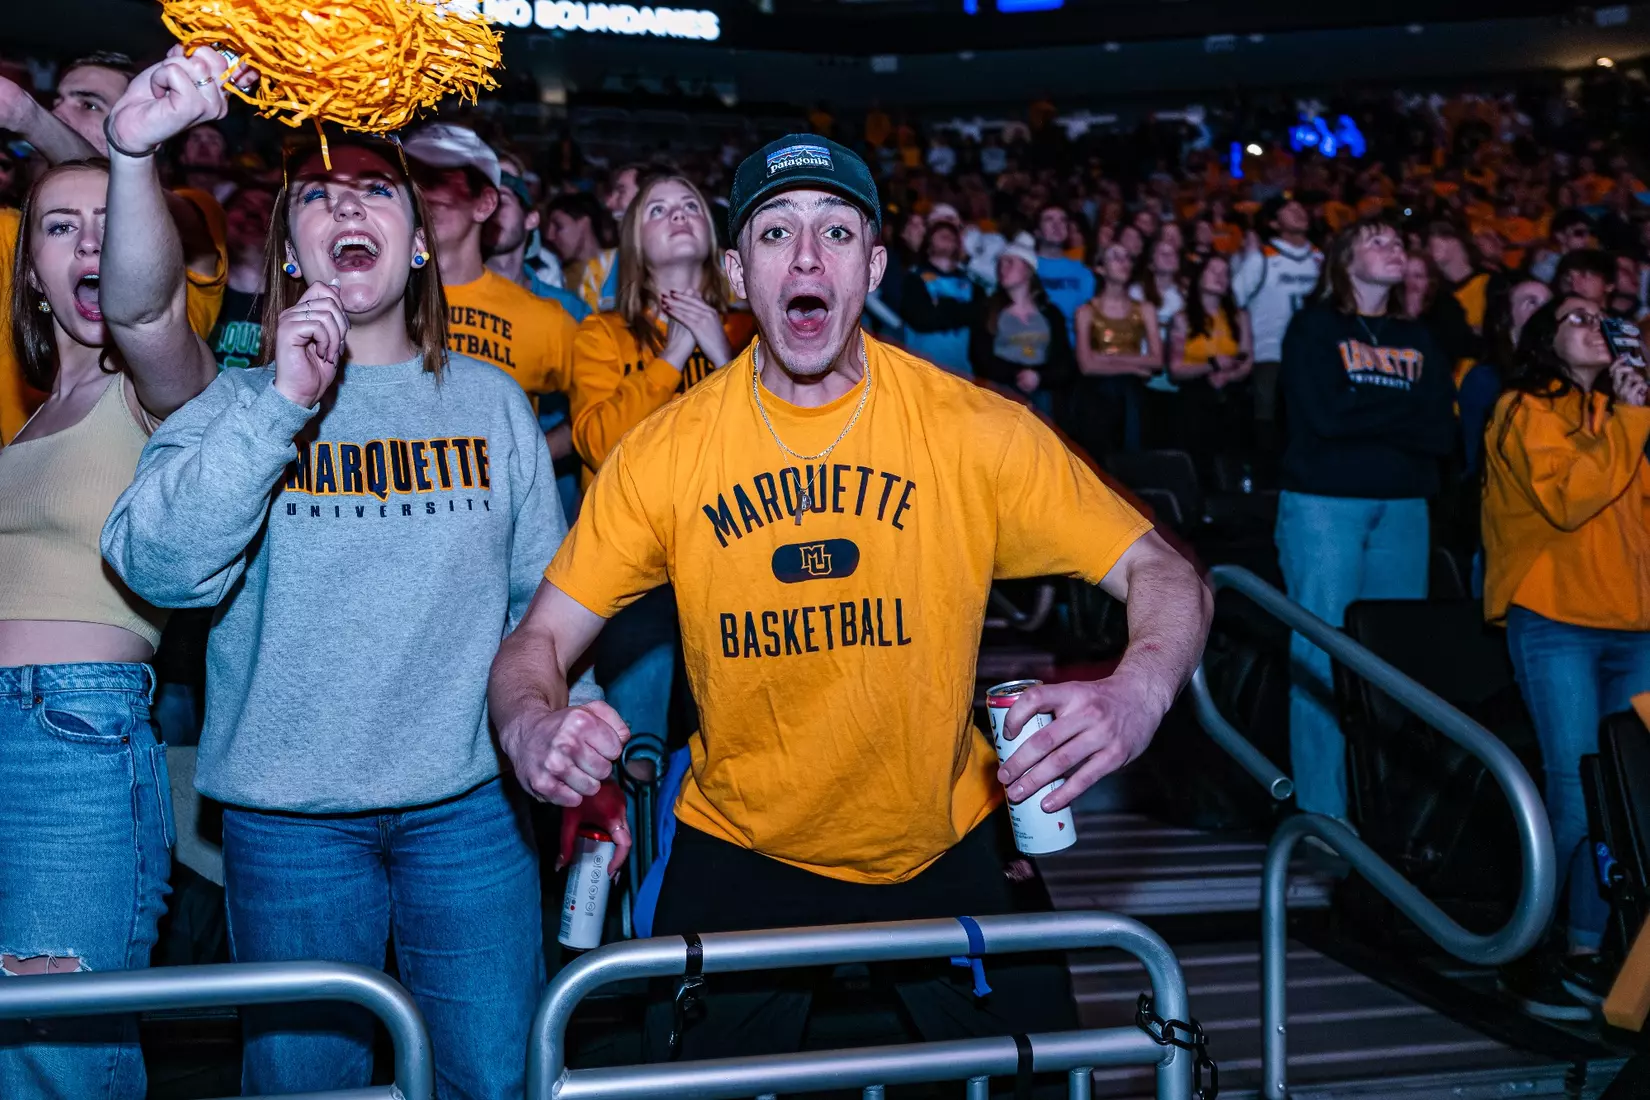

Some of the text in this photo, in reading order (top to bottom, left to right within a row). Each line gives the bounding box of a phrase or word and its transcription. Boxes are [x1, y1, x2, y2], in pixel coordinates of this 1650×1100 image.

[770, 157, 829, 174] patagonia
[450, 306, 512, 341] UETTE
[284, 436, 490, 502] MARQUETTE
[286, 499, 490, 518] UNIVERSITY
[702, 464, 916, 548] MARQUETTE
[720, 598, 912, 658] BASKETBALL
